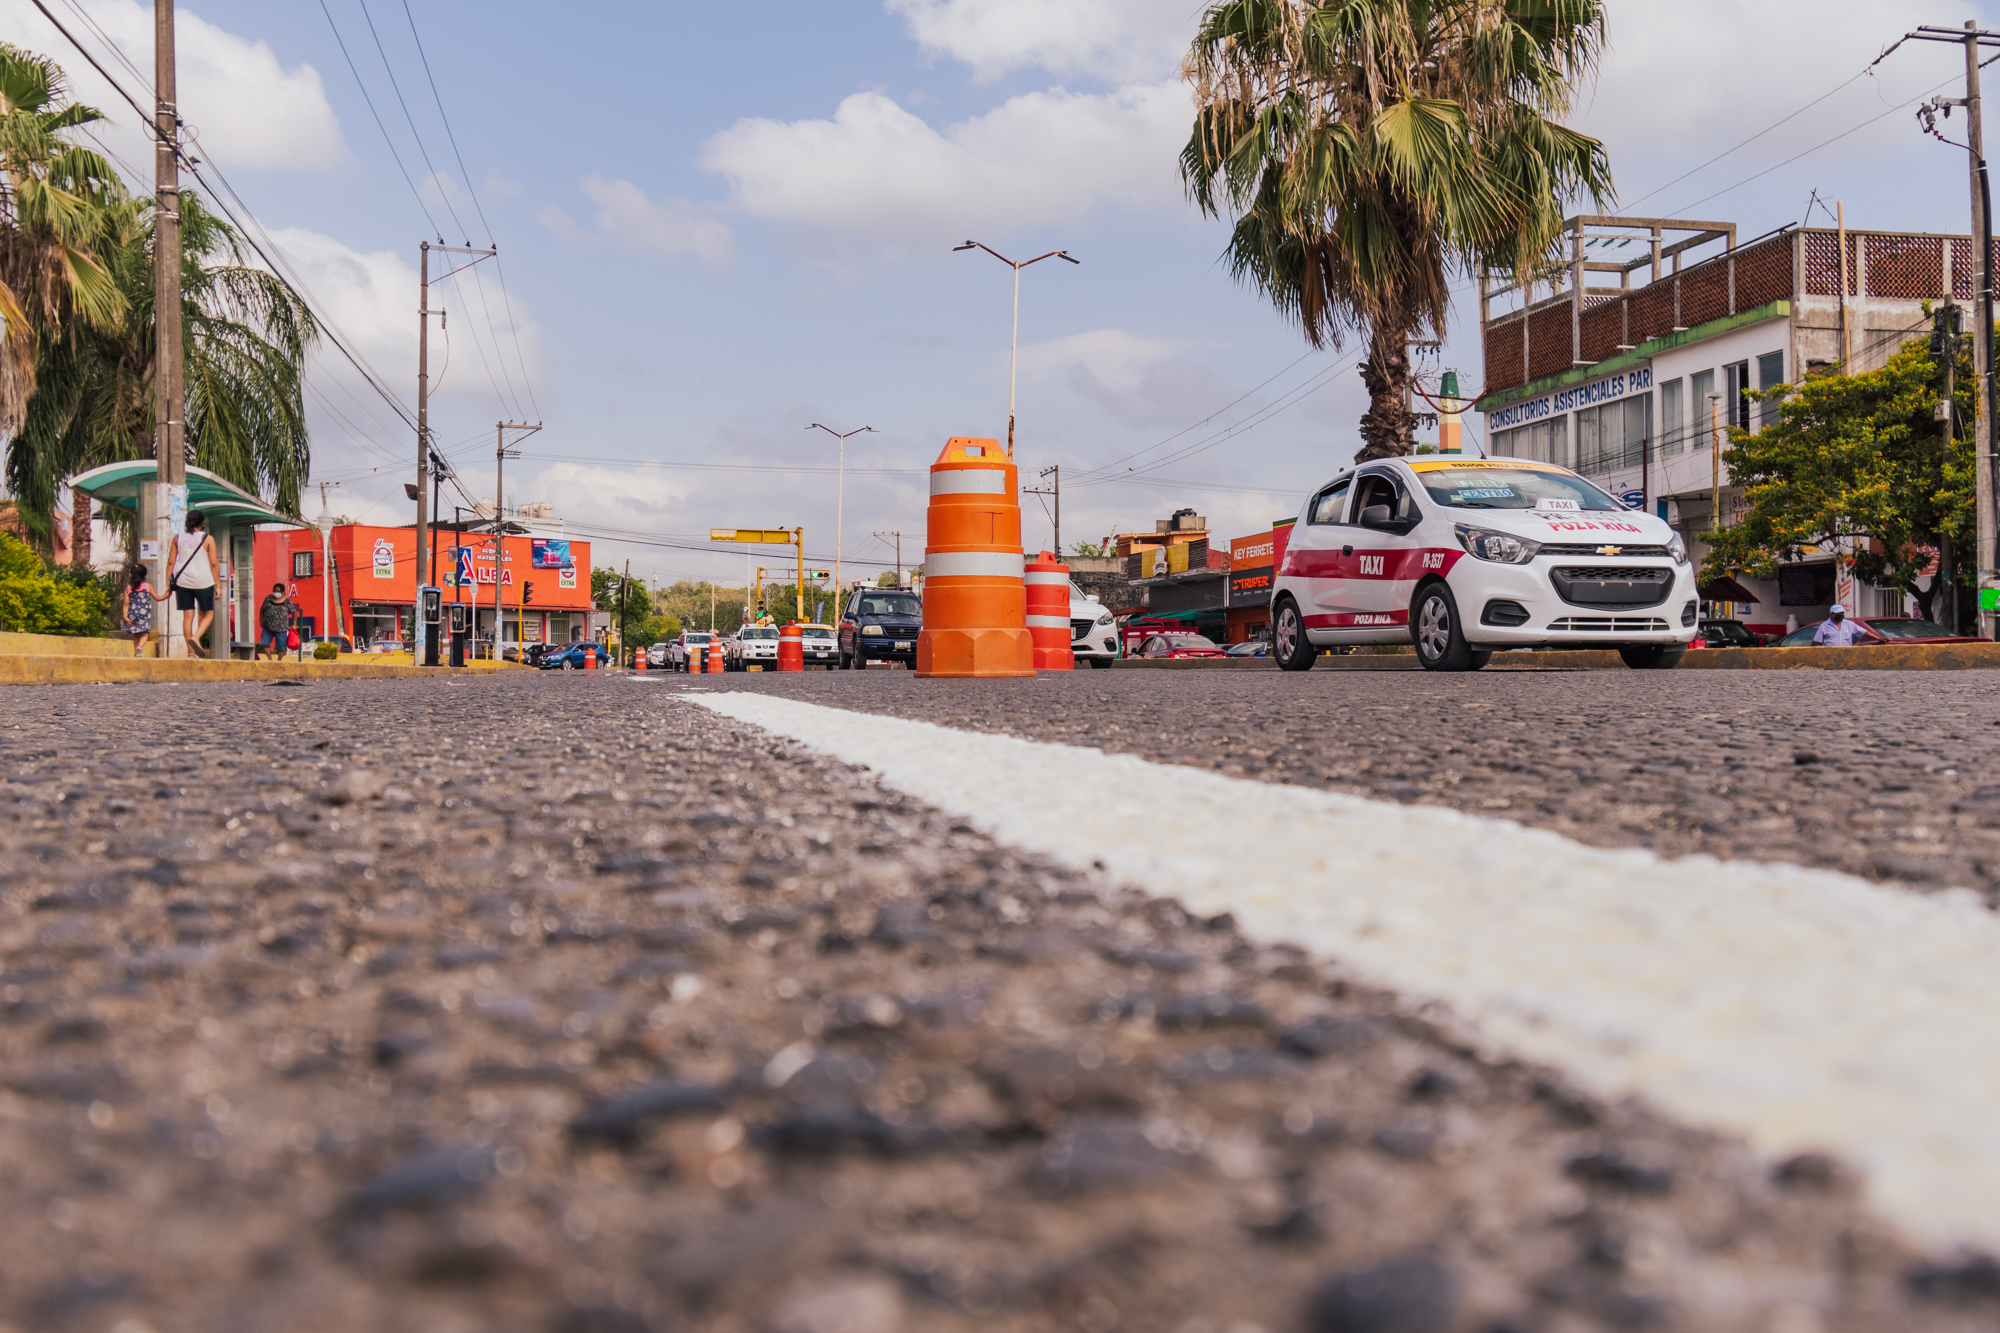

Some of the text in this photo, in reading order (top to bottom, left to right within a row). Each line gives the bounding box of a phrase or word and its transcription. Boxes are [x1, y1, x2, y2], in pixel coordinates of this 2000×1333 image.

[1490, 397, 1549, 430] CONSULTORIOS
[1554, 375, 1624, 413] ASISTENCIALES
[1460, 489, 1512, 498] CENTRO
[1548, 500, 1573, 509] TAXI
[1546, 521, 1643, 533] POZA RICA
[1233, 547, 1246, 561] KEY
[1422, 552, 1445, 569] PR-3537
[1359, 555, 1385, 576] TAXI
[1239, 575, 1270, 590] TRUPER
[1354, 614, 1391, 625] POZA RICA
